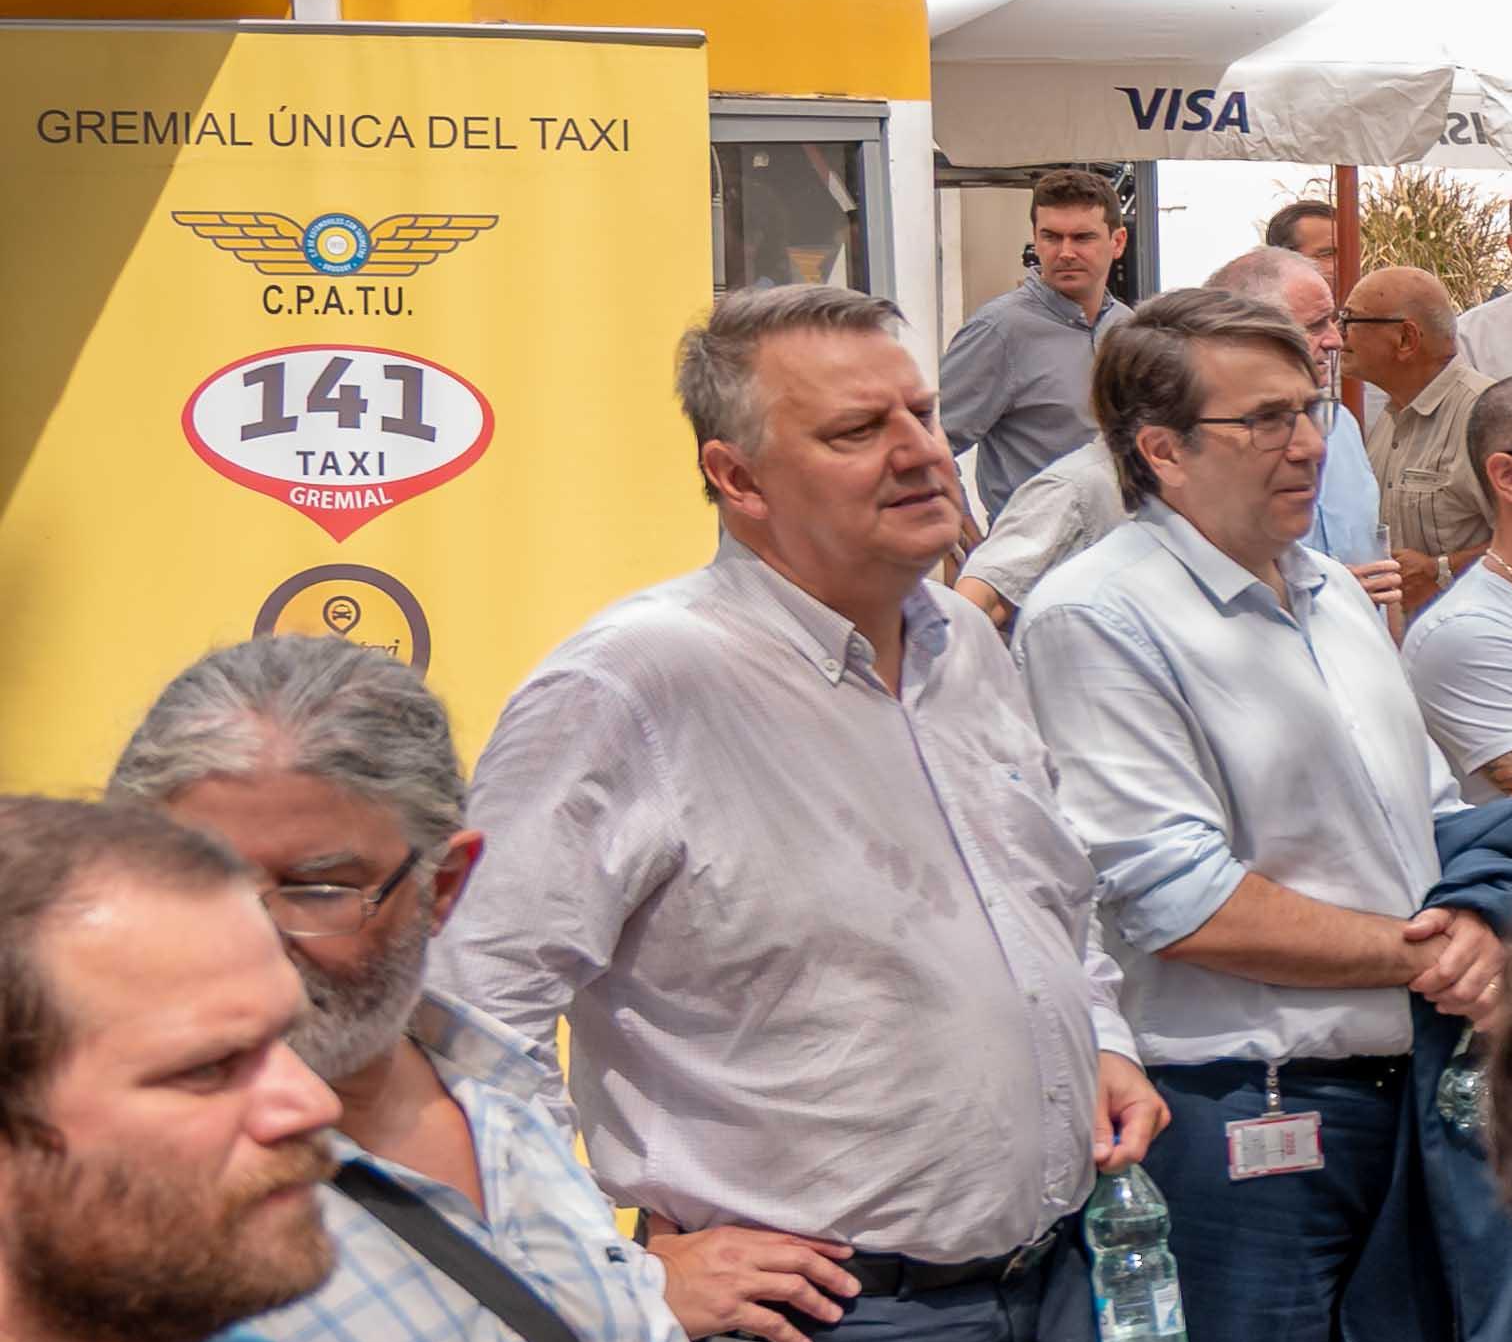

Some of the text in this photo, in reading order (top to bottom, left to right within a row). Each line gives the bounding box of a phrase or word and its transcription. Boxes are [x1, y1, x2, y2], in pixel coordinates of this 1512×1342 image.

[37, 106, 630, 151] GREMIAL ÚNICA DEL TAXI
[1113, 86, 1251, 134] VISA
[263, 286, 412, 316] C.P.A.T.U.
[240, 356, 436, 443] 141
[296, 451, 385, 476] TAXI
[289, 486, 394, 510] GREMIAL
